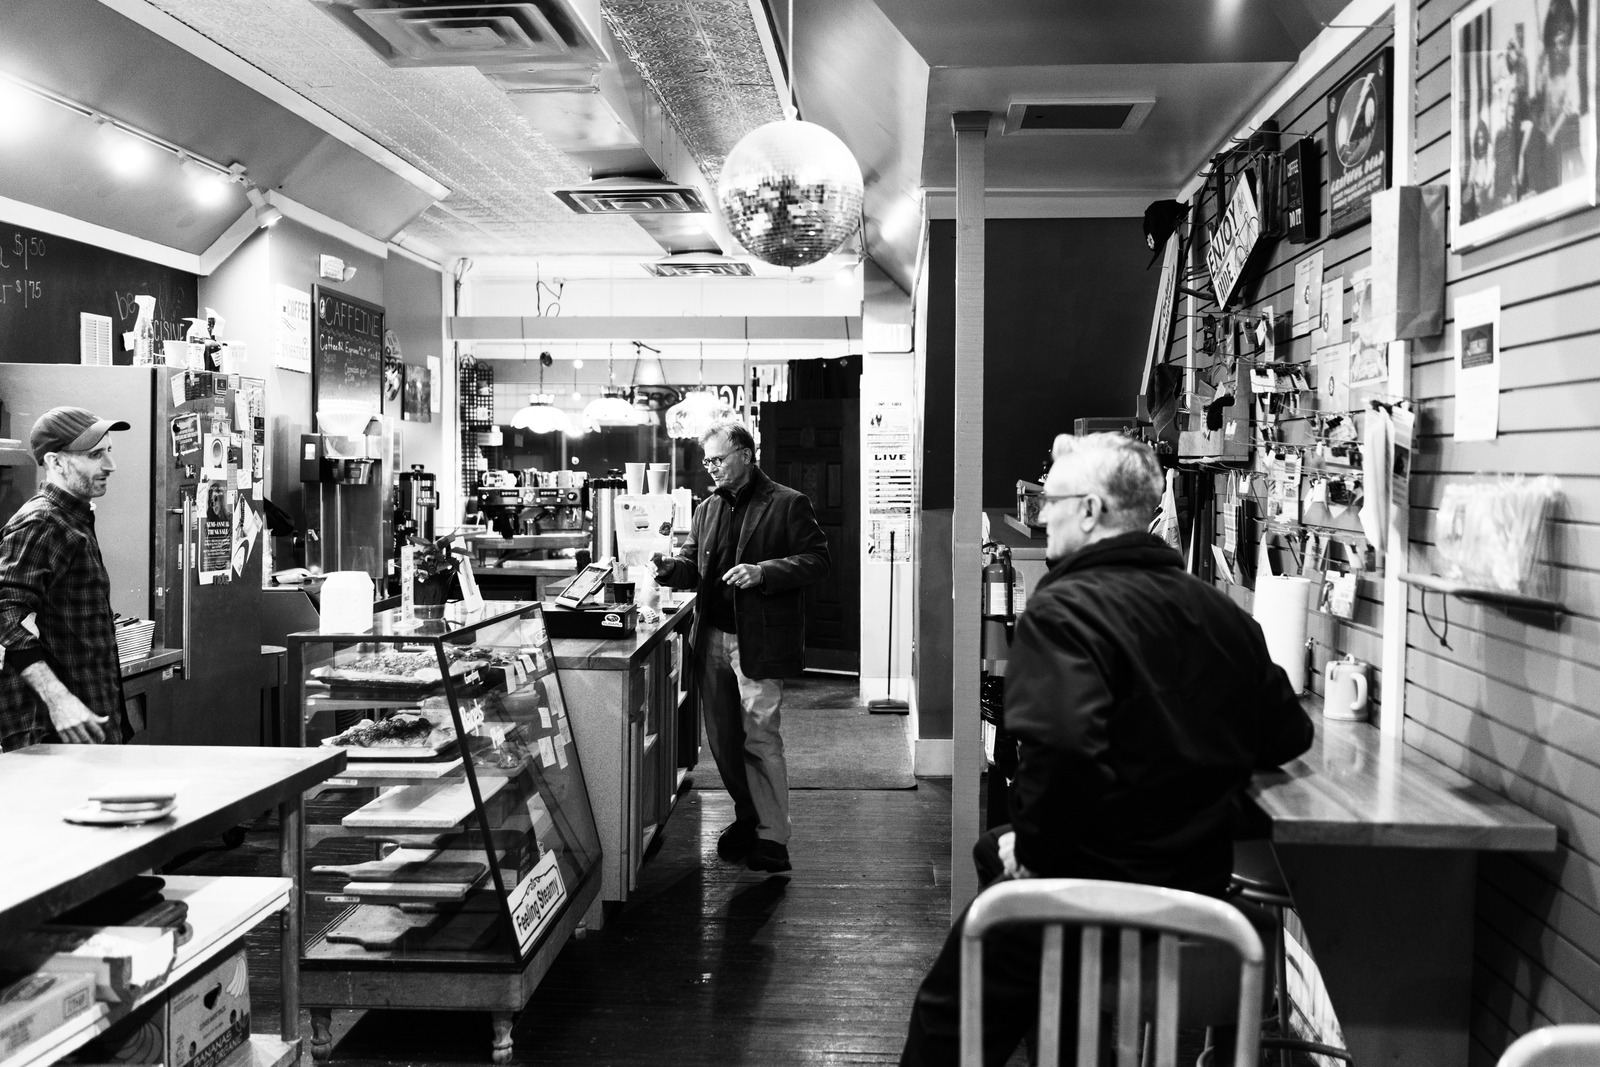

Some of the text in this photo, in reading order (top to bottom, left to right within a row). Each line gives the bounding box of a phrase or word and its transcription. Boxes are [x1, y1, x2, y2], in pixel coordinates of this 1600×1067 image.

[1208, 199, 1238, 278] ENJOY
[325, 297, 380, 338] CAFFEINE
[874, 453, 906, 461] LIVE
[516, 876, 560, 935] Feeling Steamy
[193, 1029, 233, 1067] BANANAS
